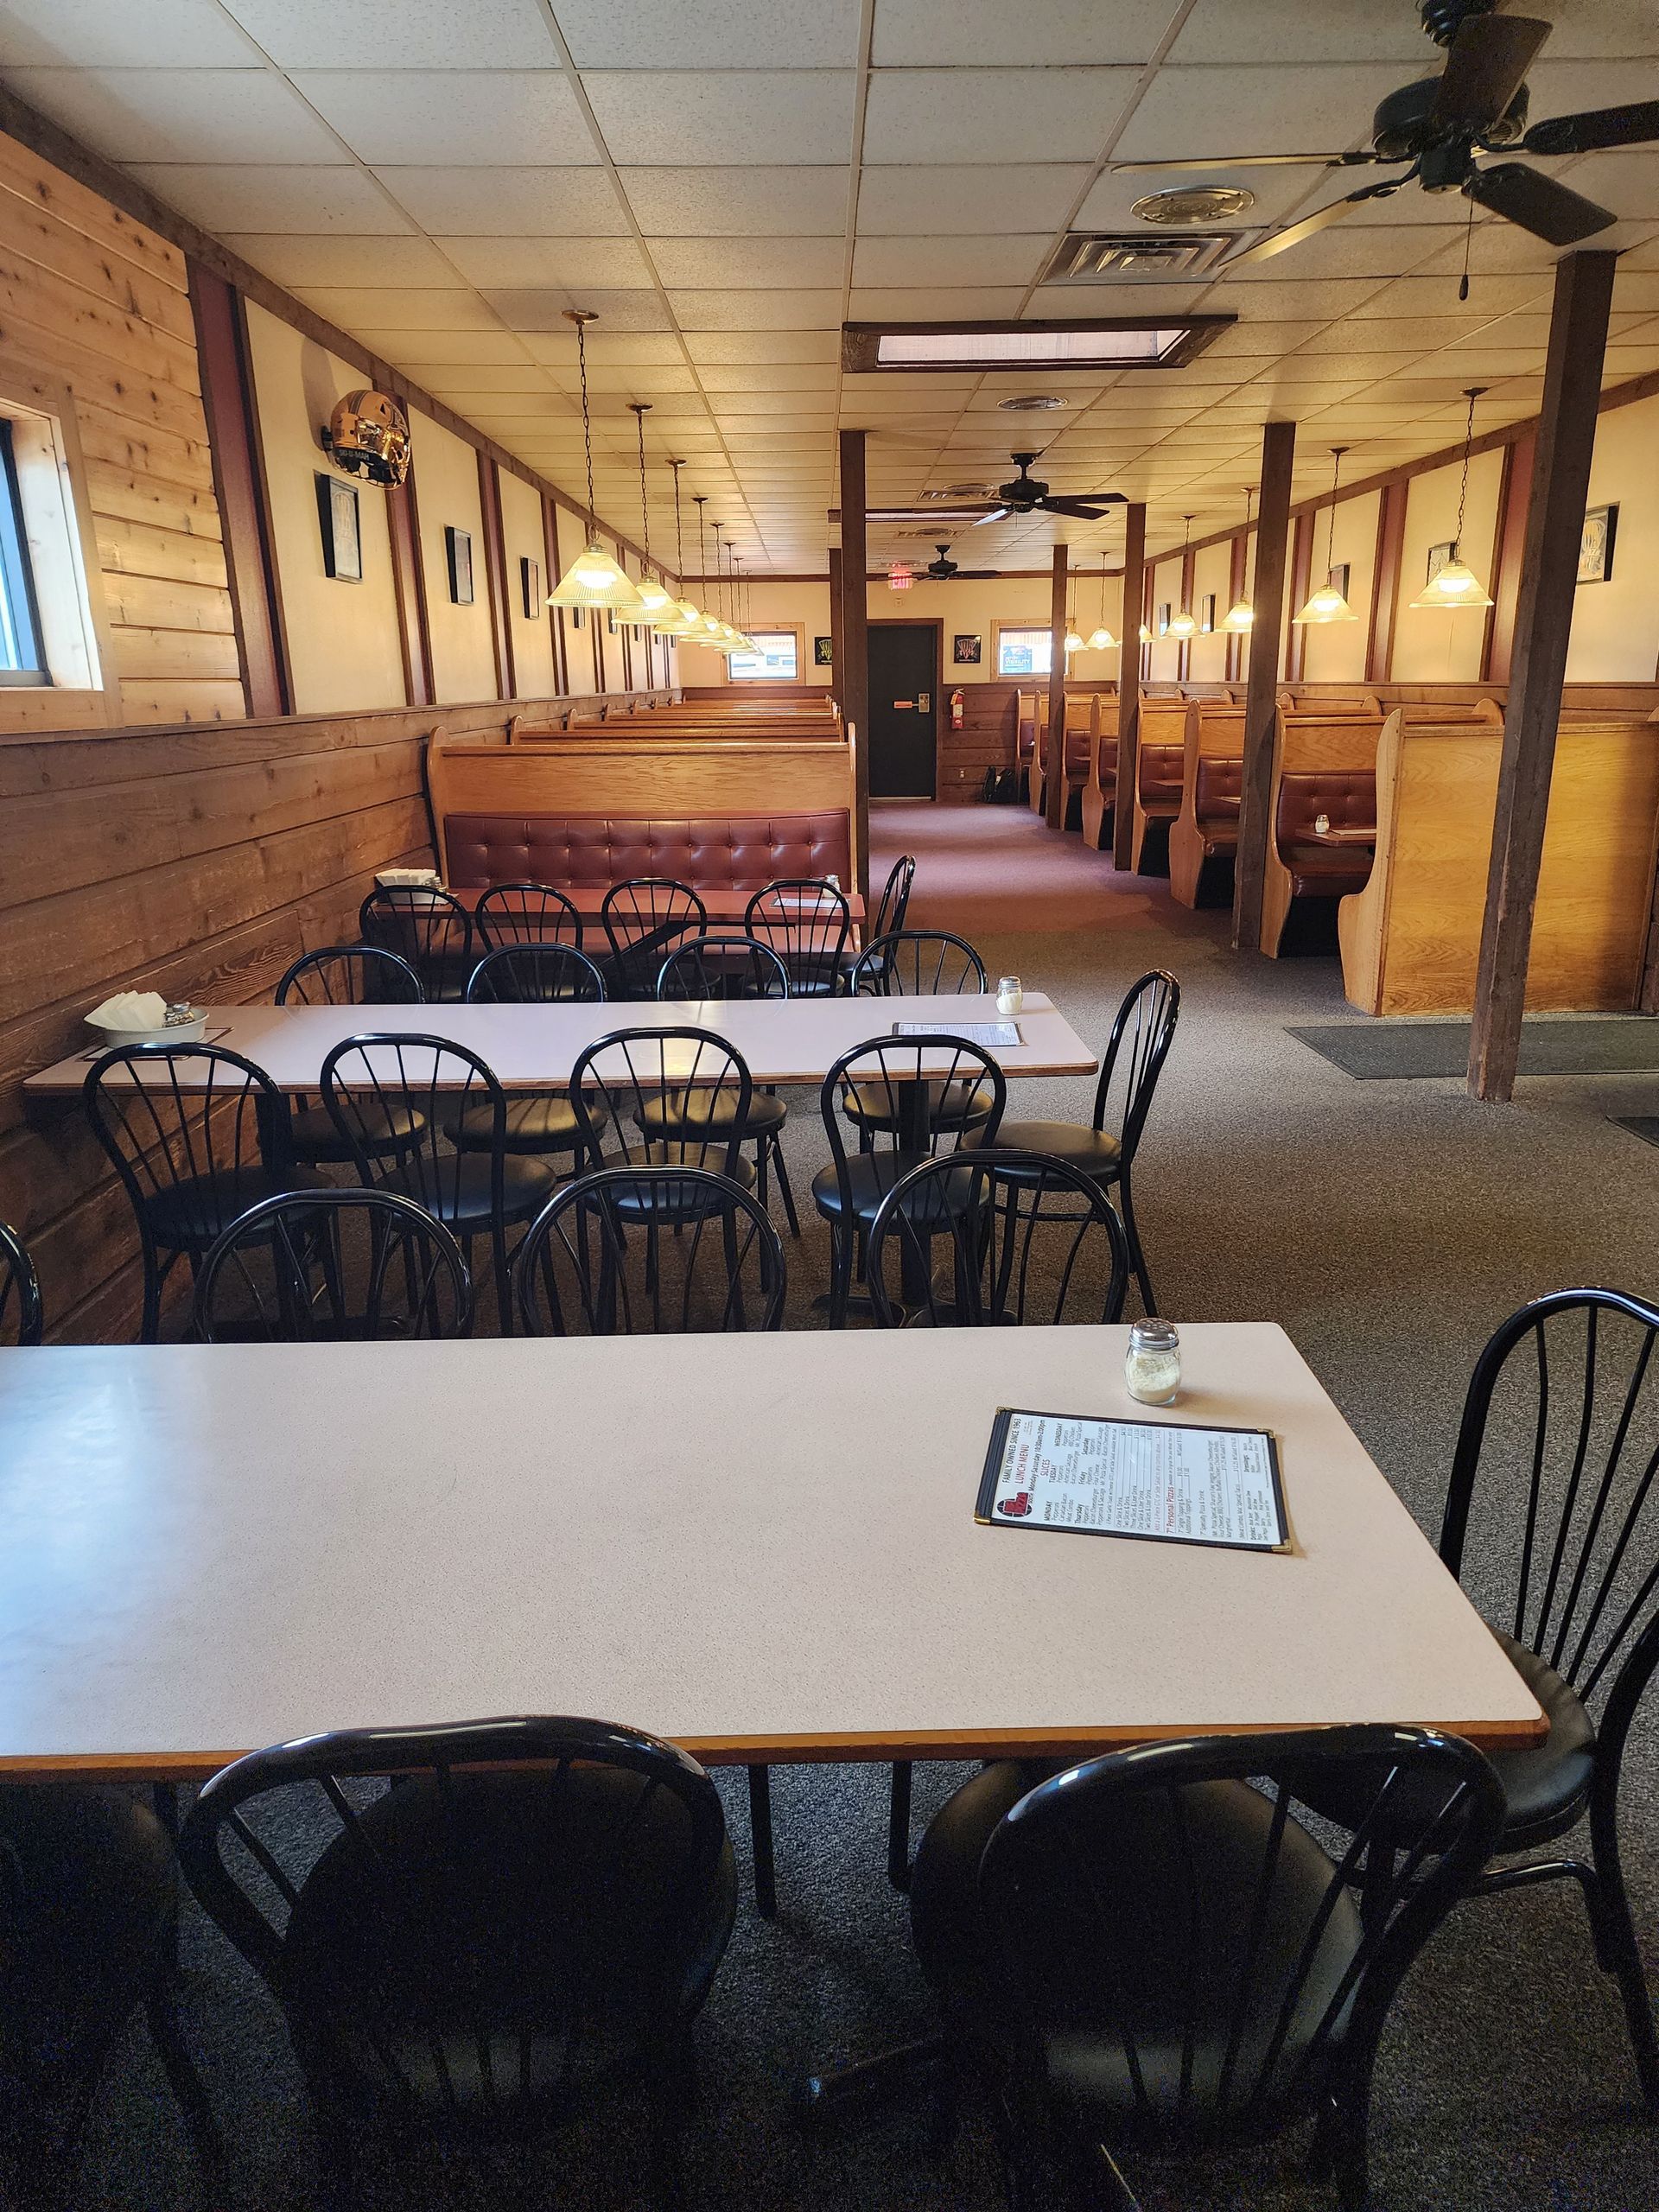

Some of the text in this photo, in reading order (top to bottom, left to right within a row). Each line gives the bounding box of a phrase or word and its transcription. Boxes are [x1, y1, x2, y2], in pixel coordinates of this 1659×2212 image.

[892, 578, 909, 589] EXIT
[1054, 1422, 1063, 1446] WEDNESDAY
[1002, 1417, 1021, 1483] FAMILY OWNED SINCE 1963
[1018, 1443, 1029, 1462] MENU
[1081, 1437, 1090, 1455] Saturday
[1014, 1463, 1026, 1484] LUNCH
[1040, 1459, 1050, 1476] SLICES
[1043, 1500, 1052, 1521] MONDAY
[1074, 1503, 1083, 1523] Thursday
[1165, 1503, 1174, 1527] Personal
